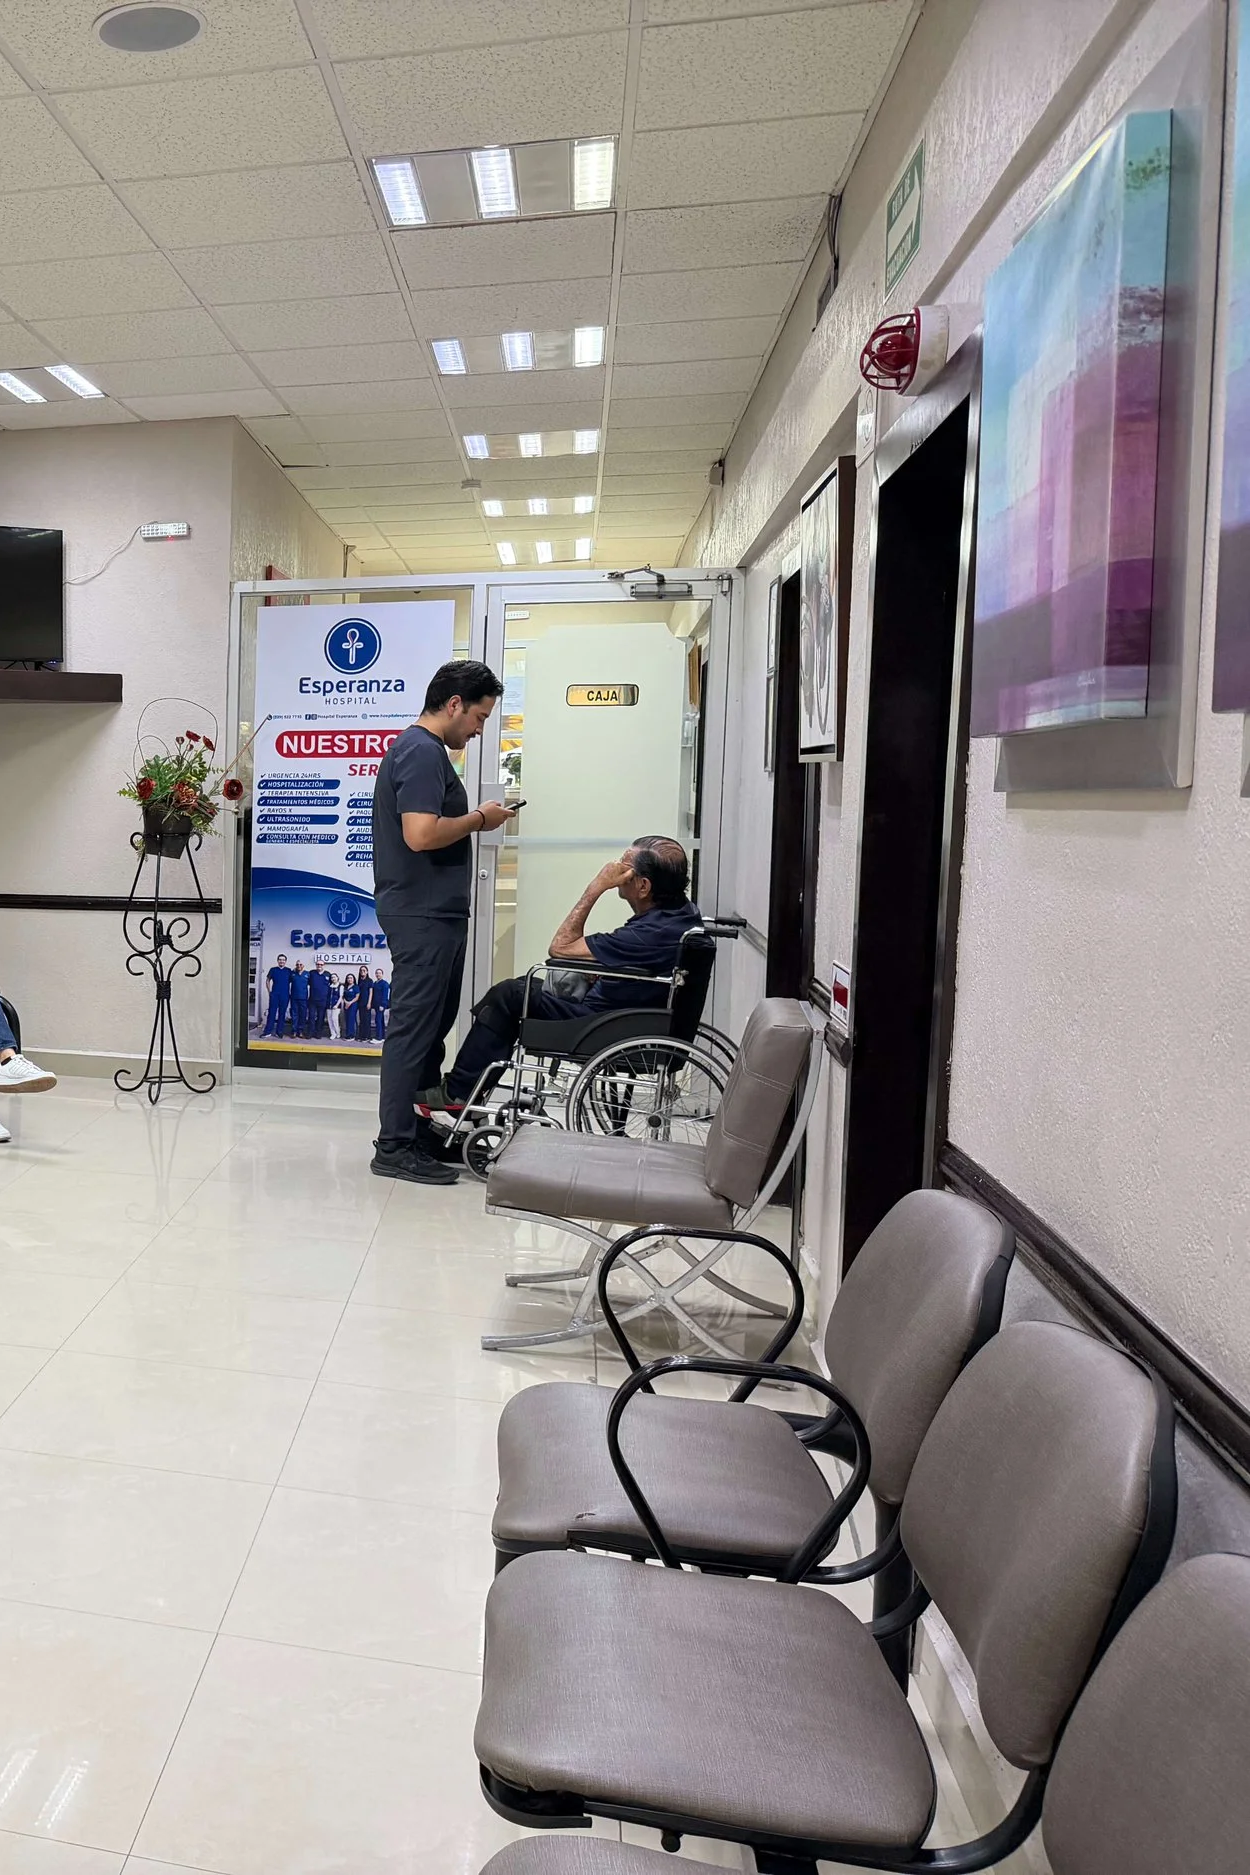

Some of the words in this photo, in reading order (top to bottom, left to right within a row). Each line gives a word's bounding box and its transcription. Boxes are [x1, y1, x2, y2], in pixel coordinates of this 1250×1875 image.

[299, 677, 405, 696] Esperanza
[325, 697, 377, 705] HOSPITAL
[586, 690, 618, 702] CAJA
[290, 930, 386, 950] Esperanz
[316, 954, 370, 962] HOSPITAL
